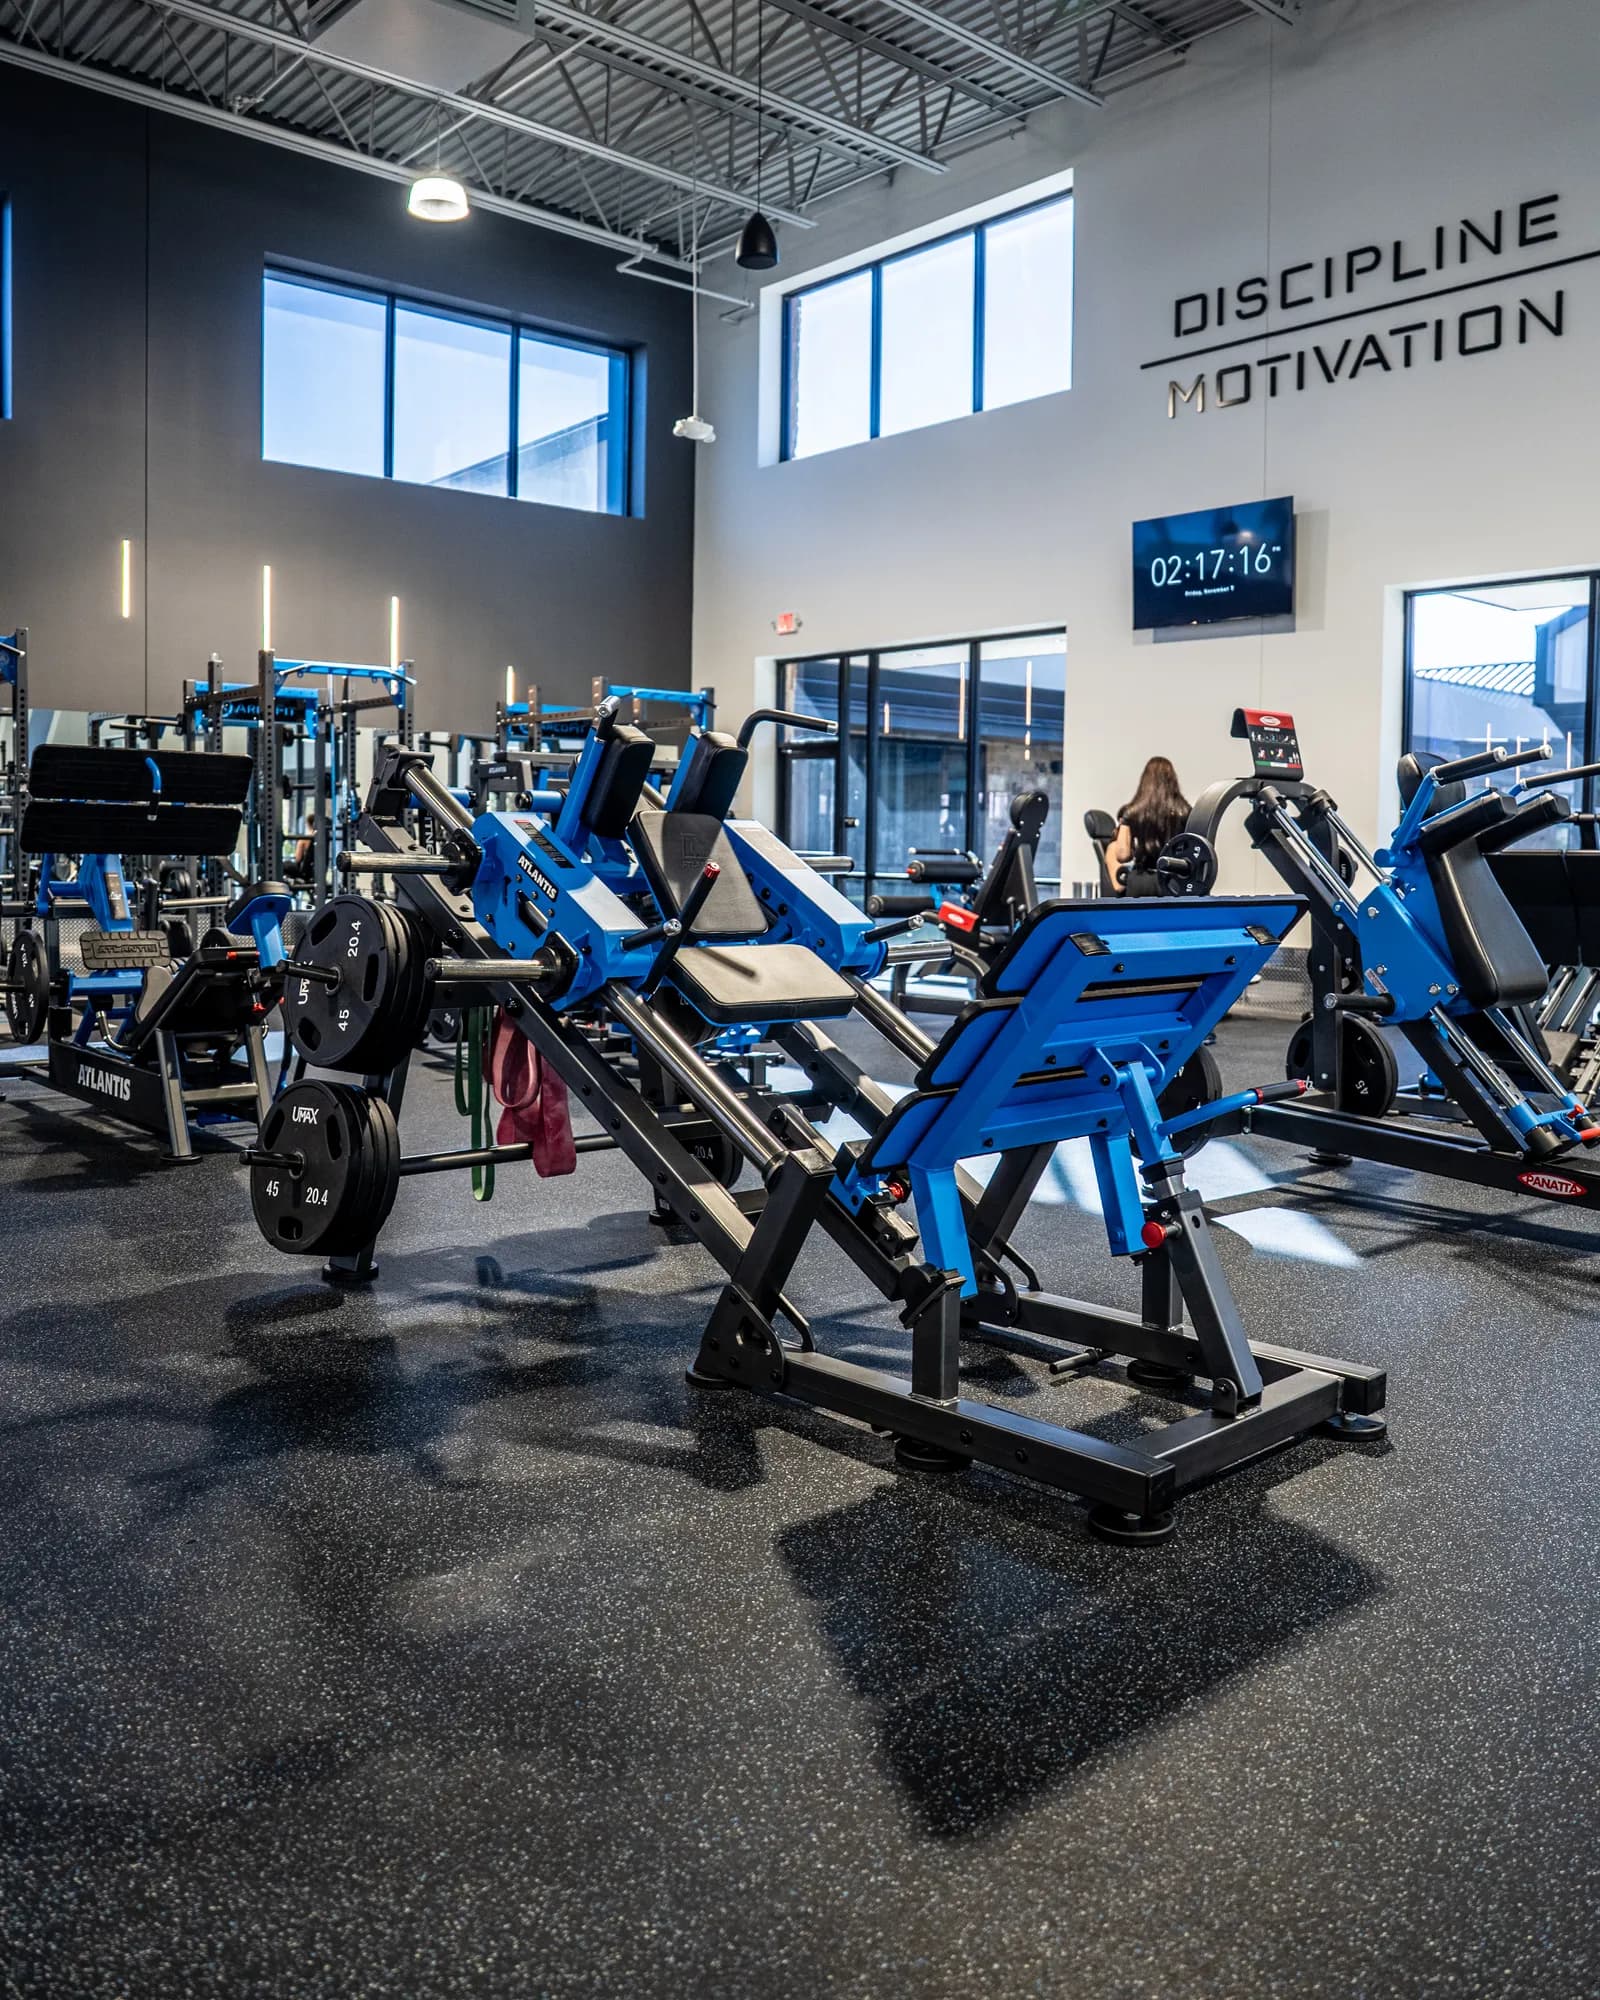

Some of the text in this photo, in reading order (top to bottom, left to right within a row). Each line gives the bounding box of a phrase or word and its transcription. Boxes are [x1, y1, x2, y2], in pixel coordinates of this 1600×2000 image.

[1174, 193, 1560, 338] DISCIPLINE
[1167, 289, 1565, 420] MOTIVATION
[1151, 543, 1271, 587] 02:17:16
[517, 855, 558, 899] ATLANTIS
[347, 920, 361, 957] 20.4
[338, 1009, 350, 1031] 45
[77, 1063, 131, 1101] ATLANTIS
[1355, 1080, 1369, 1095] 45
[292, 1105, 320, 1125] UMAX
[266, 1180, 280, 1197] 45
[305, 1186, 329, 1206] 20.4
[1527, 1175, 1579, 1194] PANATTA
